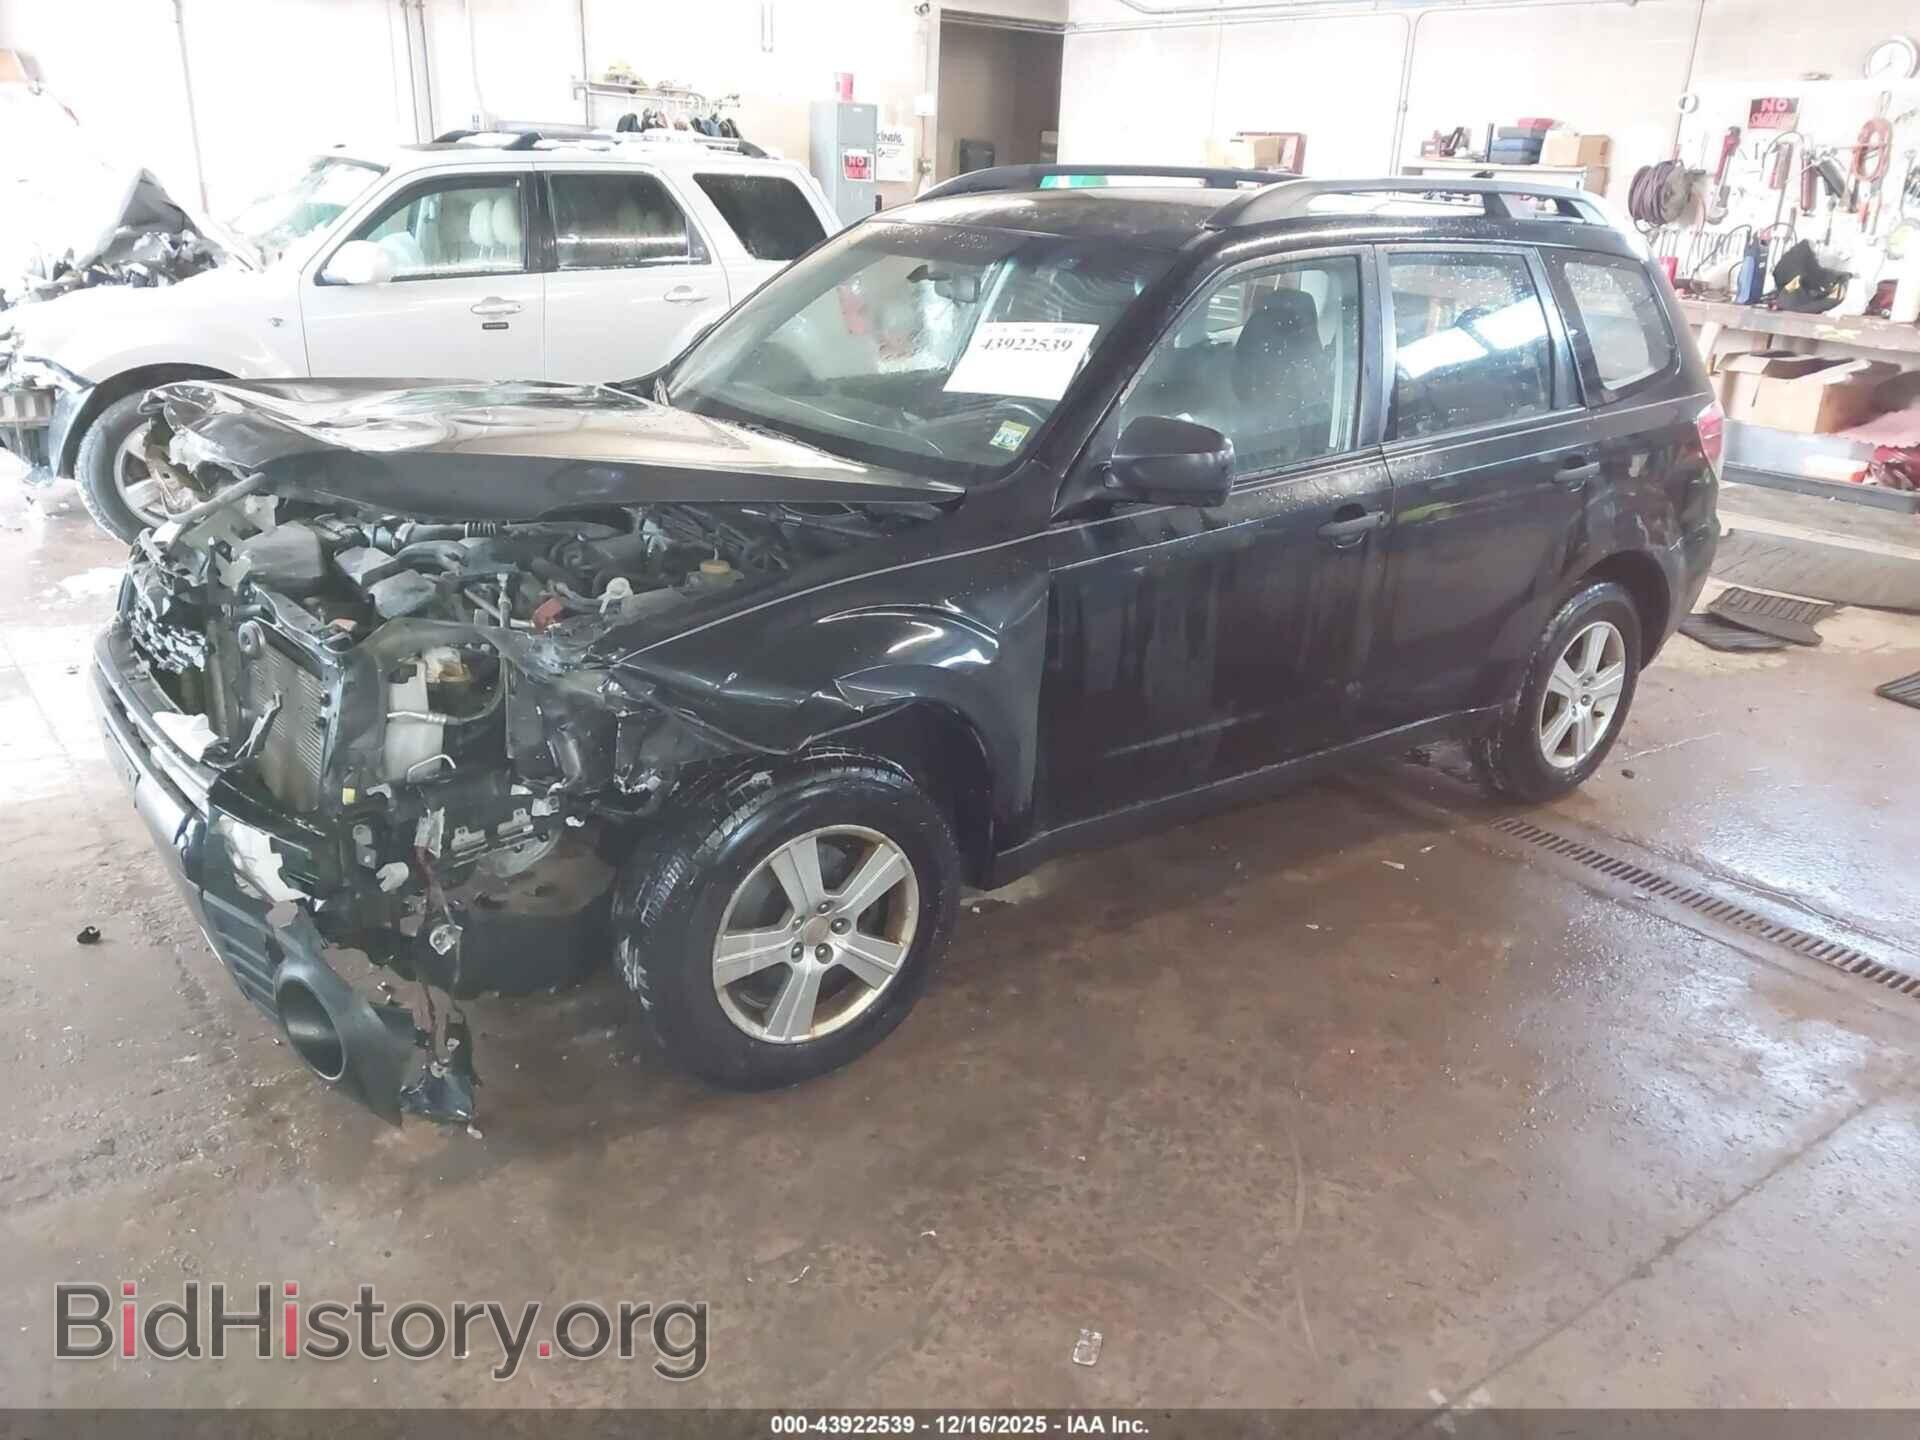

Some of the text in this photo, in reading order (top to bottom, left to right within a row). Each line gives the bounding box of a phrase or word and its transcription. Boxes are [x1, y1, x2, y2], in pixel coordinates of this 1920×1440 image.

[1760, 97, 1788, 112] NO
[848, 154, 865, 167] NO
[979, 337, 1074, 352] 43922539
